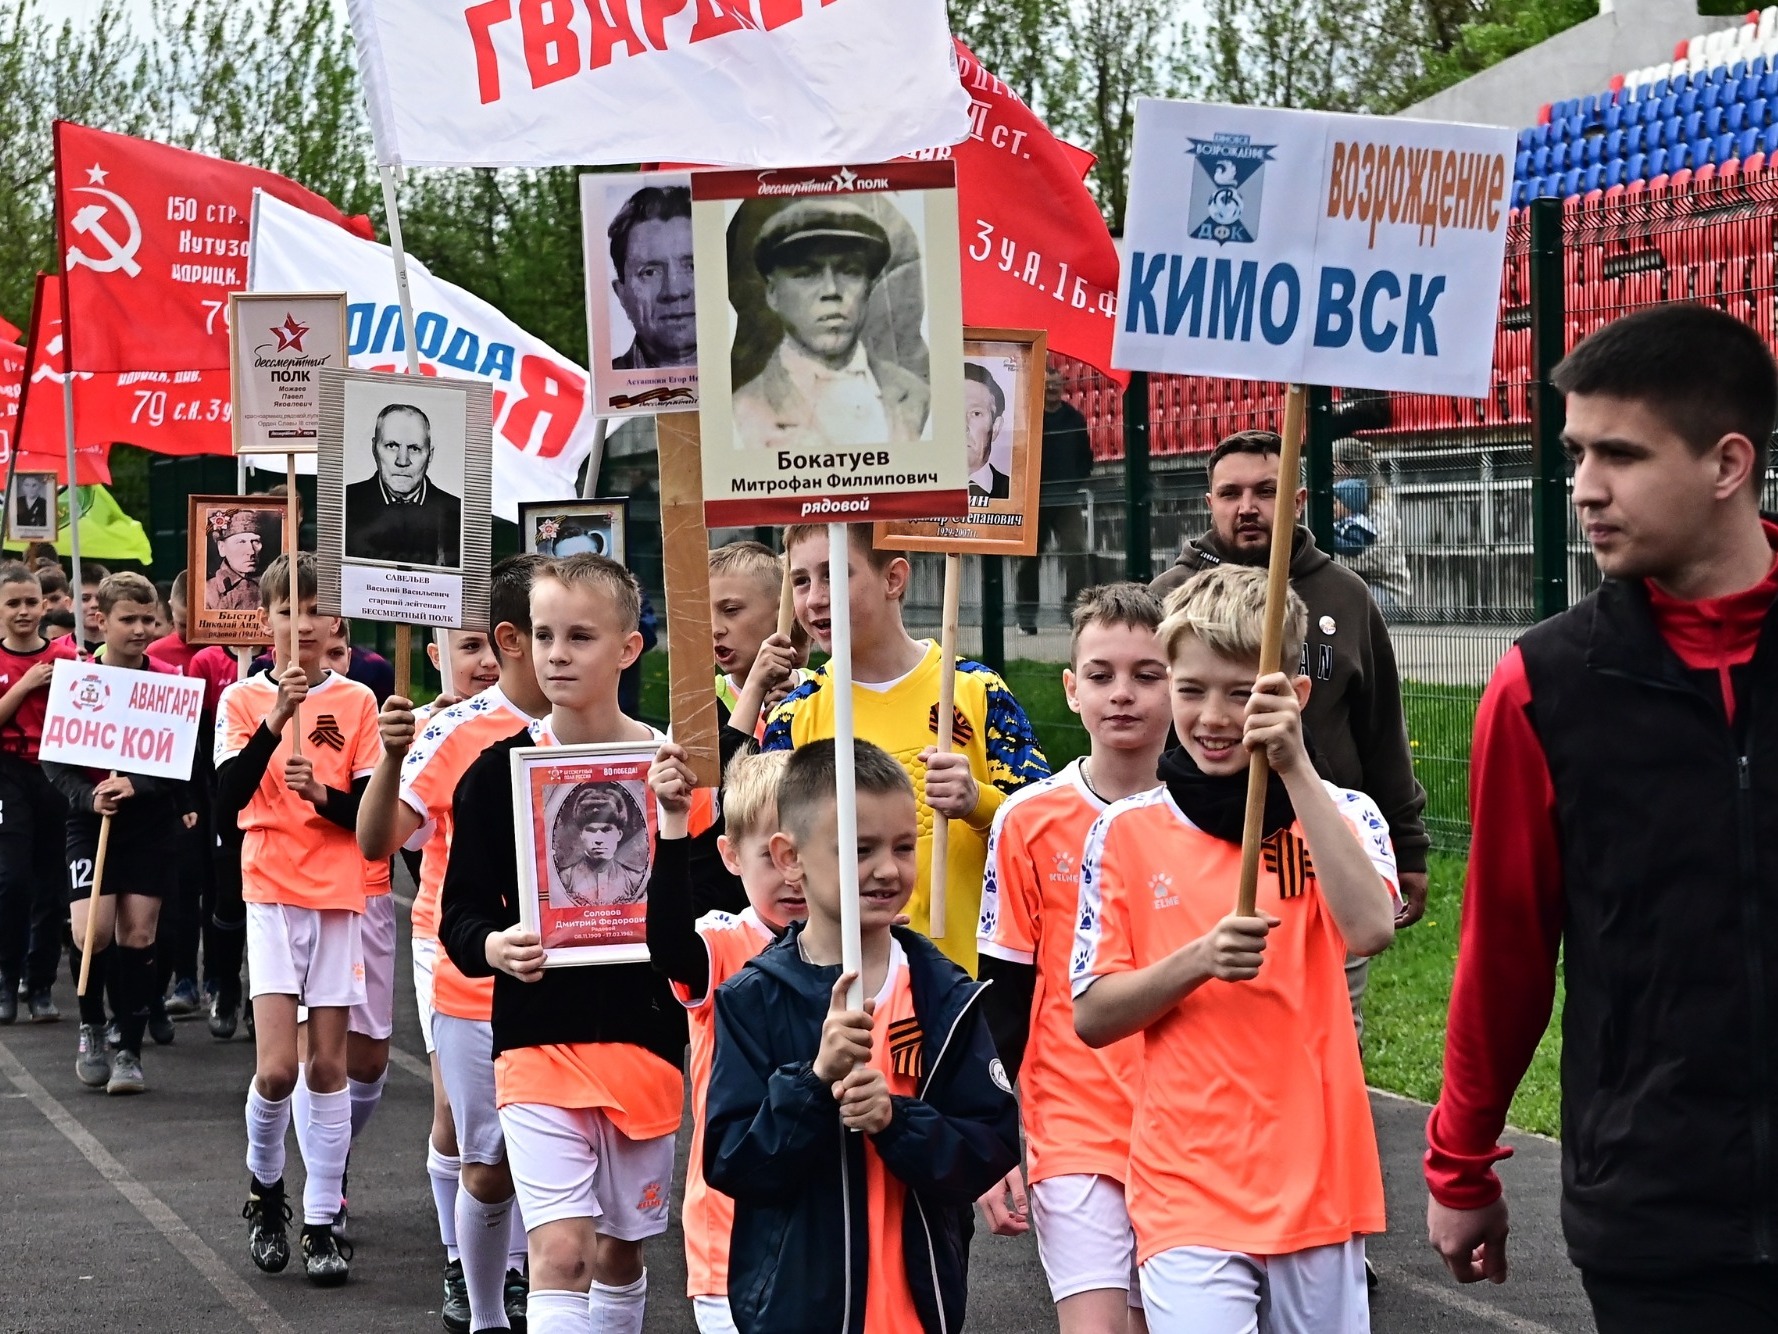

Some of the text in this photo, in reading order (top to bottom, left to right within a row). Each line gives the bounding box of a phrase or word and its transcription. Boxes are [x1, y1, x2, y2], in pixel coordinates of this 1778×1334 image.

[857, 177, 889, 190] ПОЛК
[167, 196, 197, 222] 150
[969, 219, 994, 261] 3
[271, 370, 311, 383] ПОЛК
[131, 390, 167, 427] 79
[777, 450, 890, 473] Бокатуев
[731, 473, 938, 494] Митрофан Филлипович
[801, 496, 870, 518] рядовой
[385, 573, 431, 584] САВЕЛЬЕВ
[366, 583, 450, 599] Василий Васильевич
[361, 607, 454, 623] БЕССМЕРТНЫЙ ПОЛК
[128, 681, 200, 724] АВАНГАРД
[69, 858, 93, 889] 12
[555, 919, 597, 929] Дмитрий
